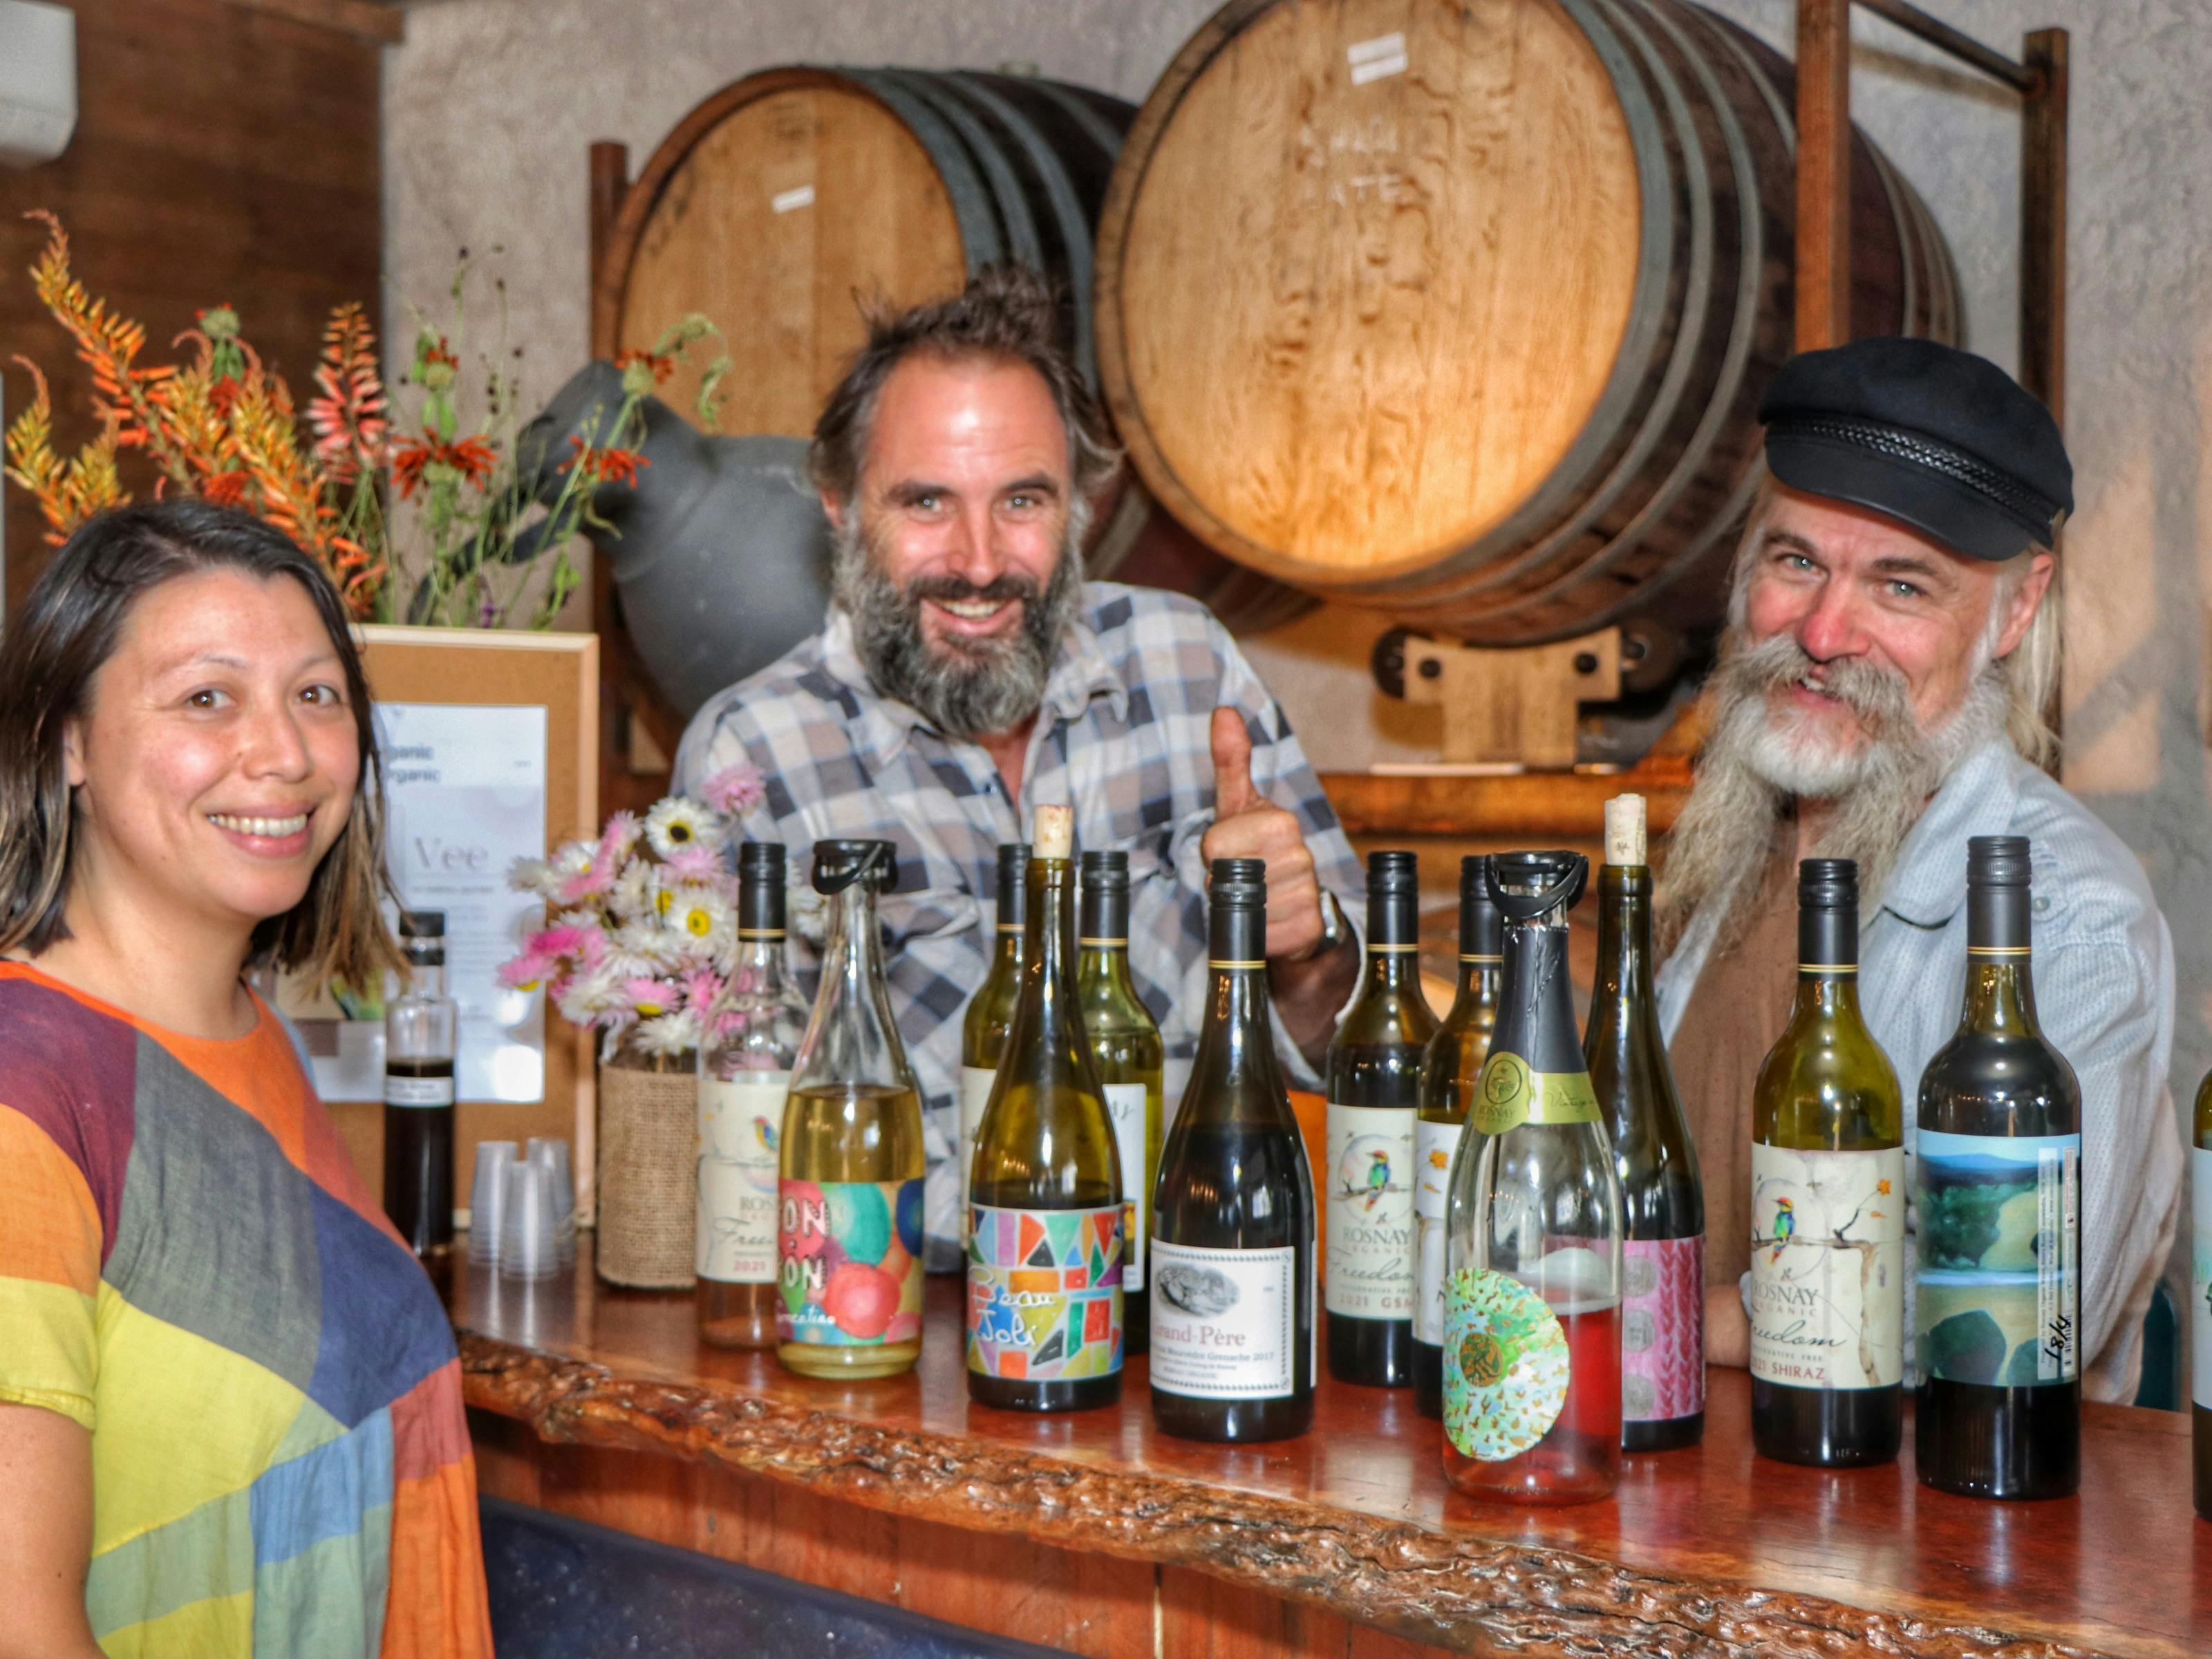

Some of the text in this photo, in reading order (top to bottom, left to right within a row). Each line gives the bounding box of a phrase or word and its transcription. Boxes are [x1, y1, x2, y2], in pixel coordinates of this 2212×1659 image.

[1343, 1226, 1410, 1244] ROSNAY
[733, 1260, 766, 1273] 2021
[1752, 1279, 1819, 1306] ROSNAY
[1754, 1300, 1817, 1317] RGANIC
[976, 1309, 1037, 1347] Joli
[1253, 1351, 1275, 1362] 2017
[1801, 1353, 1823, 1362] FREE
[1772, 1362, 1825, 1380] SHIRAZ
